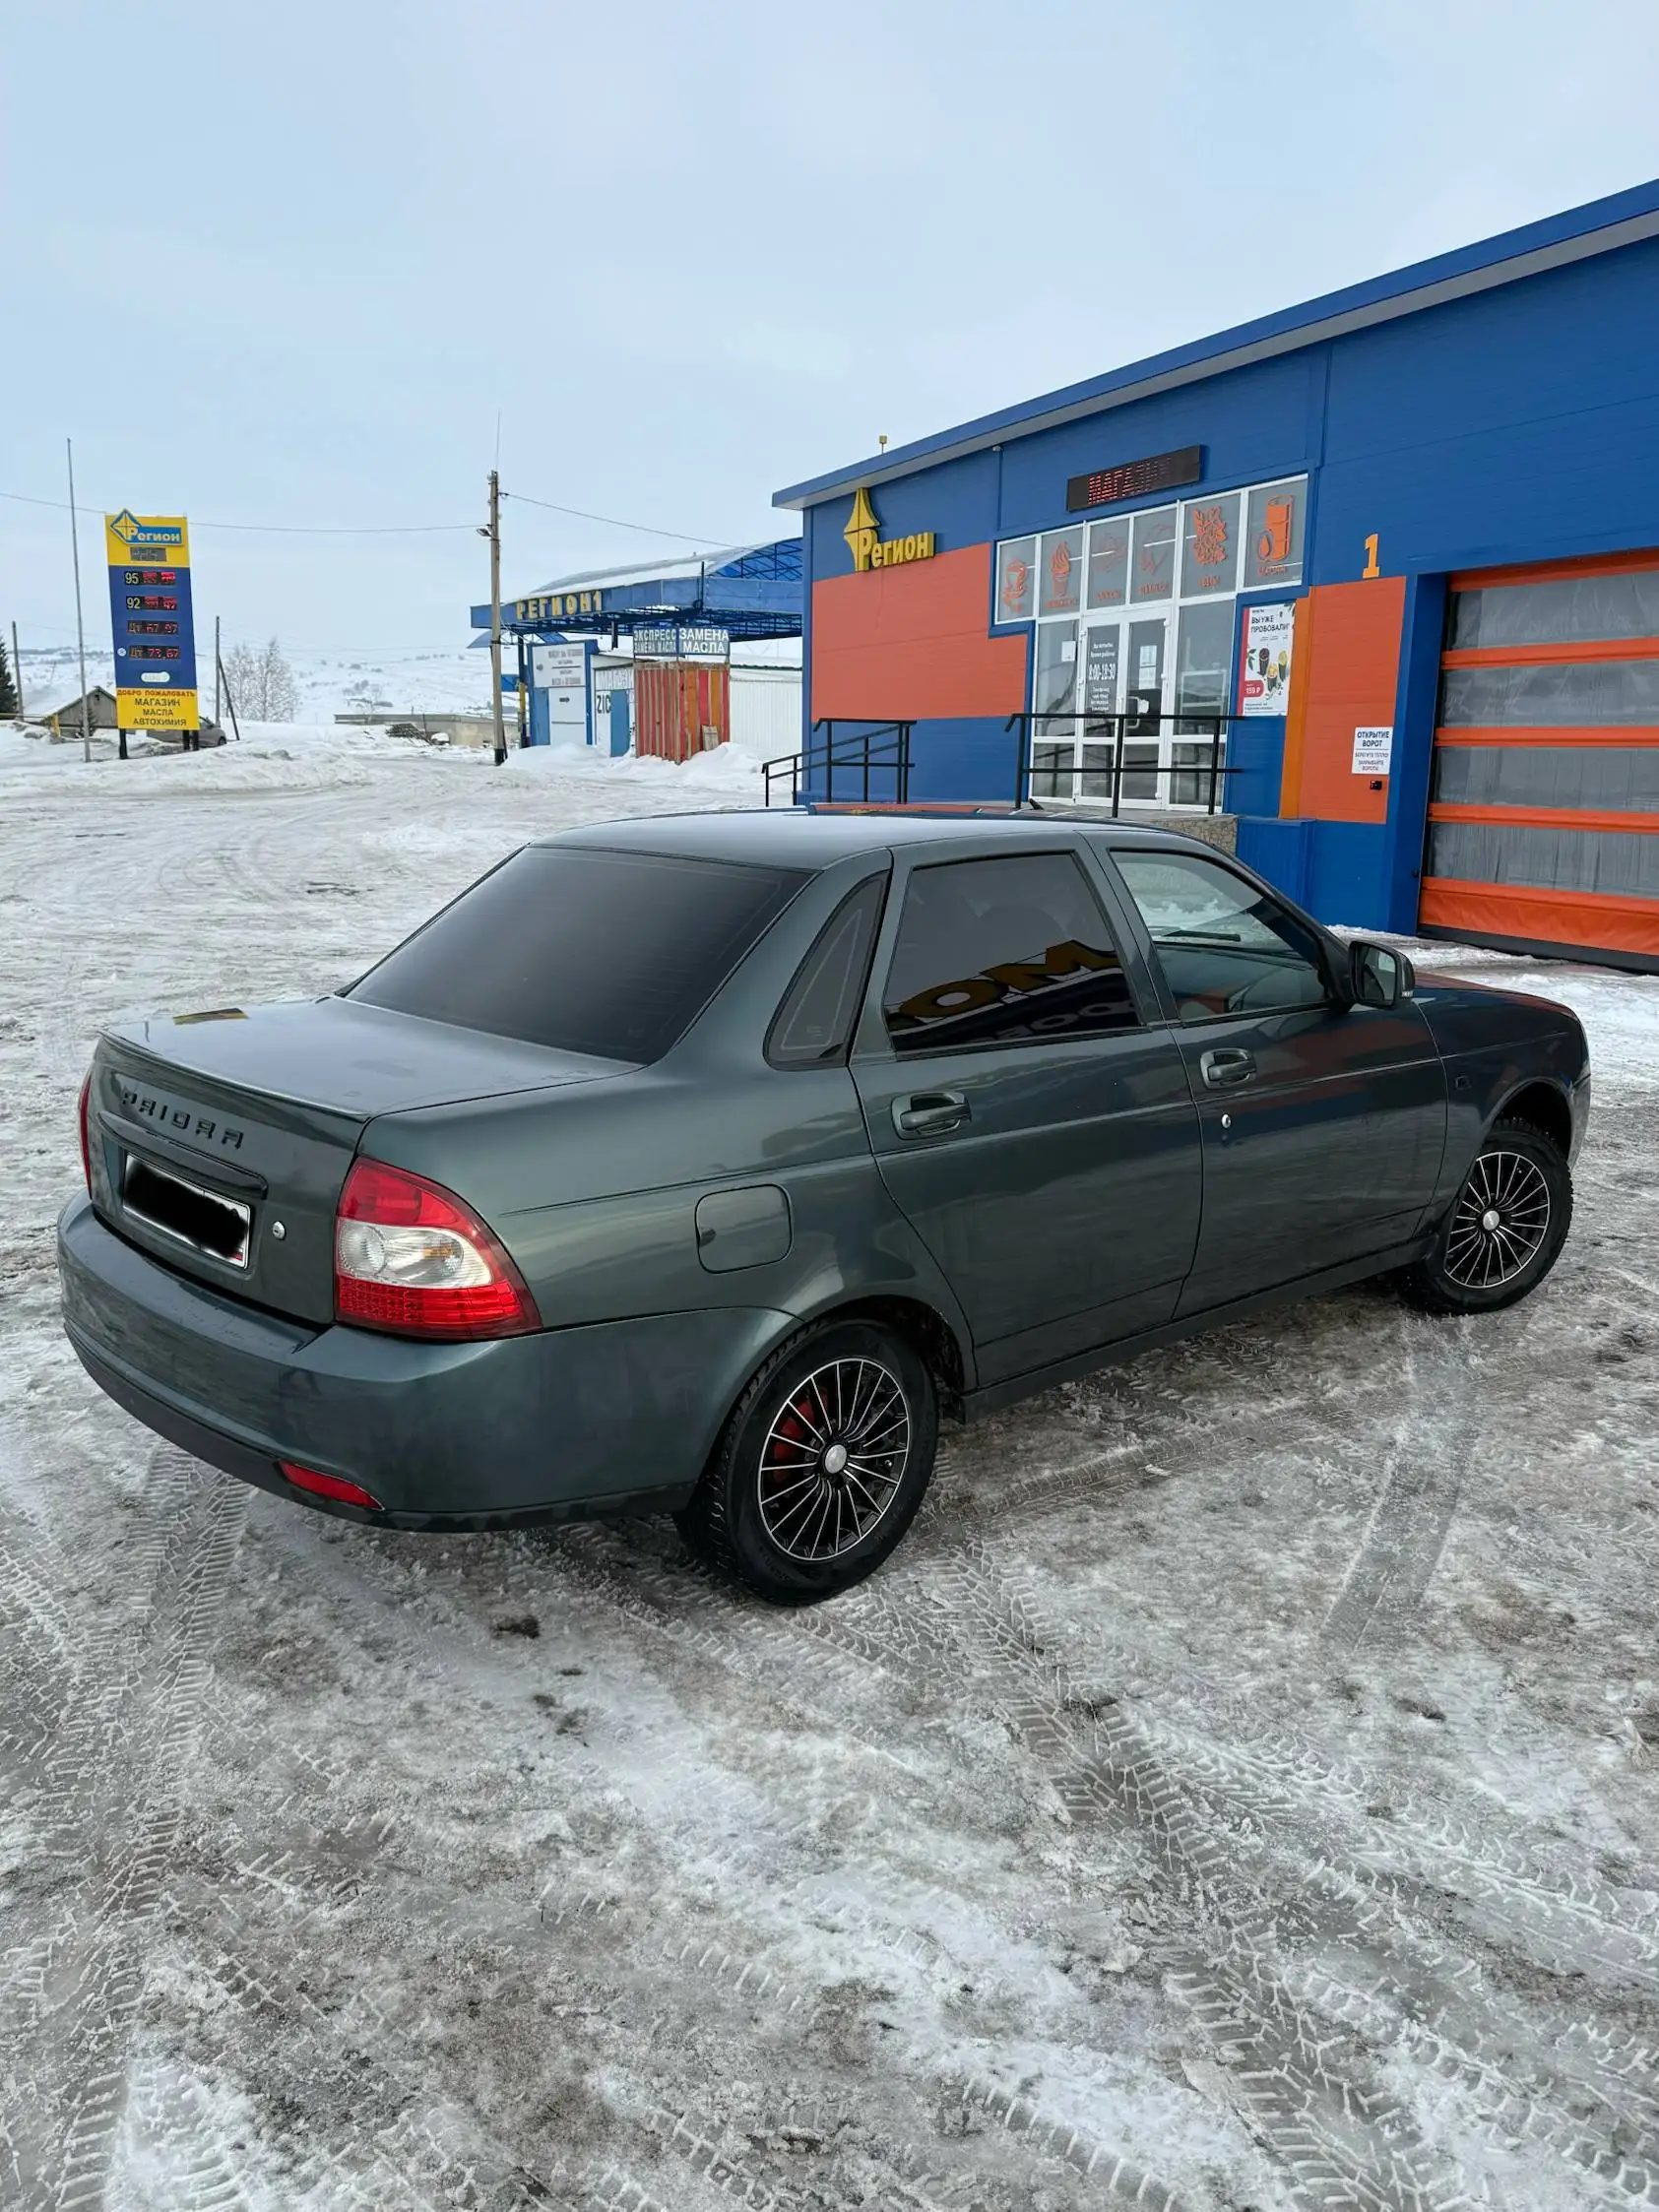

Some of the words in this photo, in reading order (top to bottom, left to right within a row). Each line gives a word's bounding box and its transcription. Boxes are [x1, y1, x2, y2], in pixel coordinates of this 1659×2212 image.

[127, 527, 180, 541] Регион
[857, 529, 934, 571] Регион
[1363, 534, 1379, 579] 1
[125, 572, 139, 584] 95
[127, 597, 141, 609] 92
[634, 629, 677, 641] ЭКСПРЕСС
[679, 628, 729, 641] ЗАМЕНА
[683, 641, 726, 654] МАСЛА
[135, 698, 180, 707] МАГАЗИН
[143, 708, 174, 717] МАСЛА
[133, 718, 187, 727] АВТОХИМИЯ
[122, 1090, 244, 1150] PRIORA
